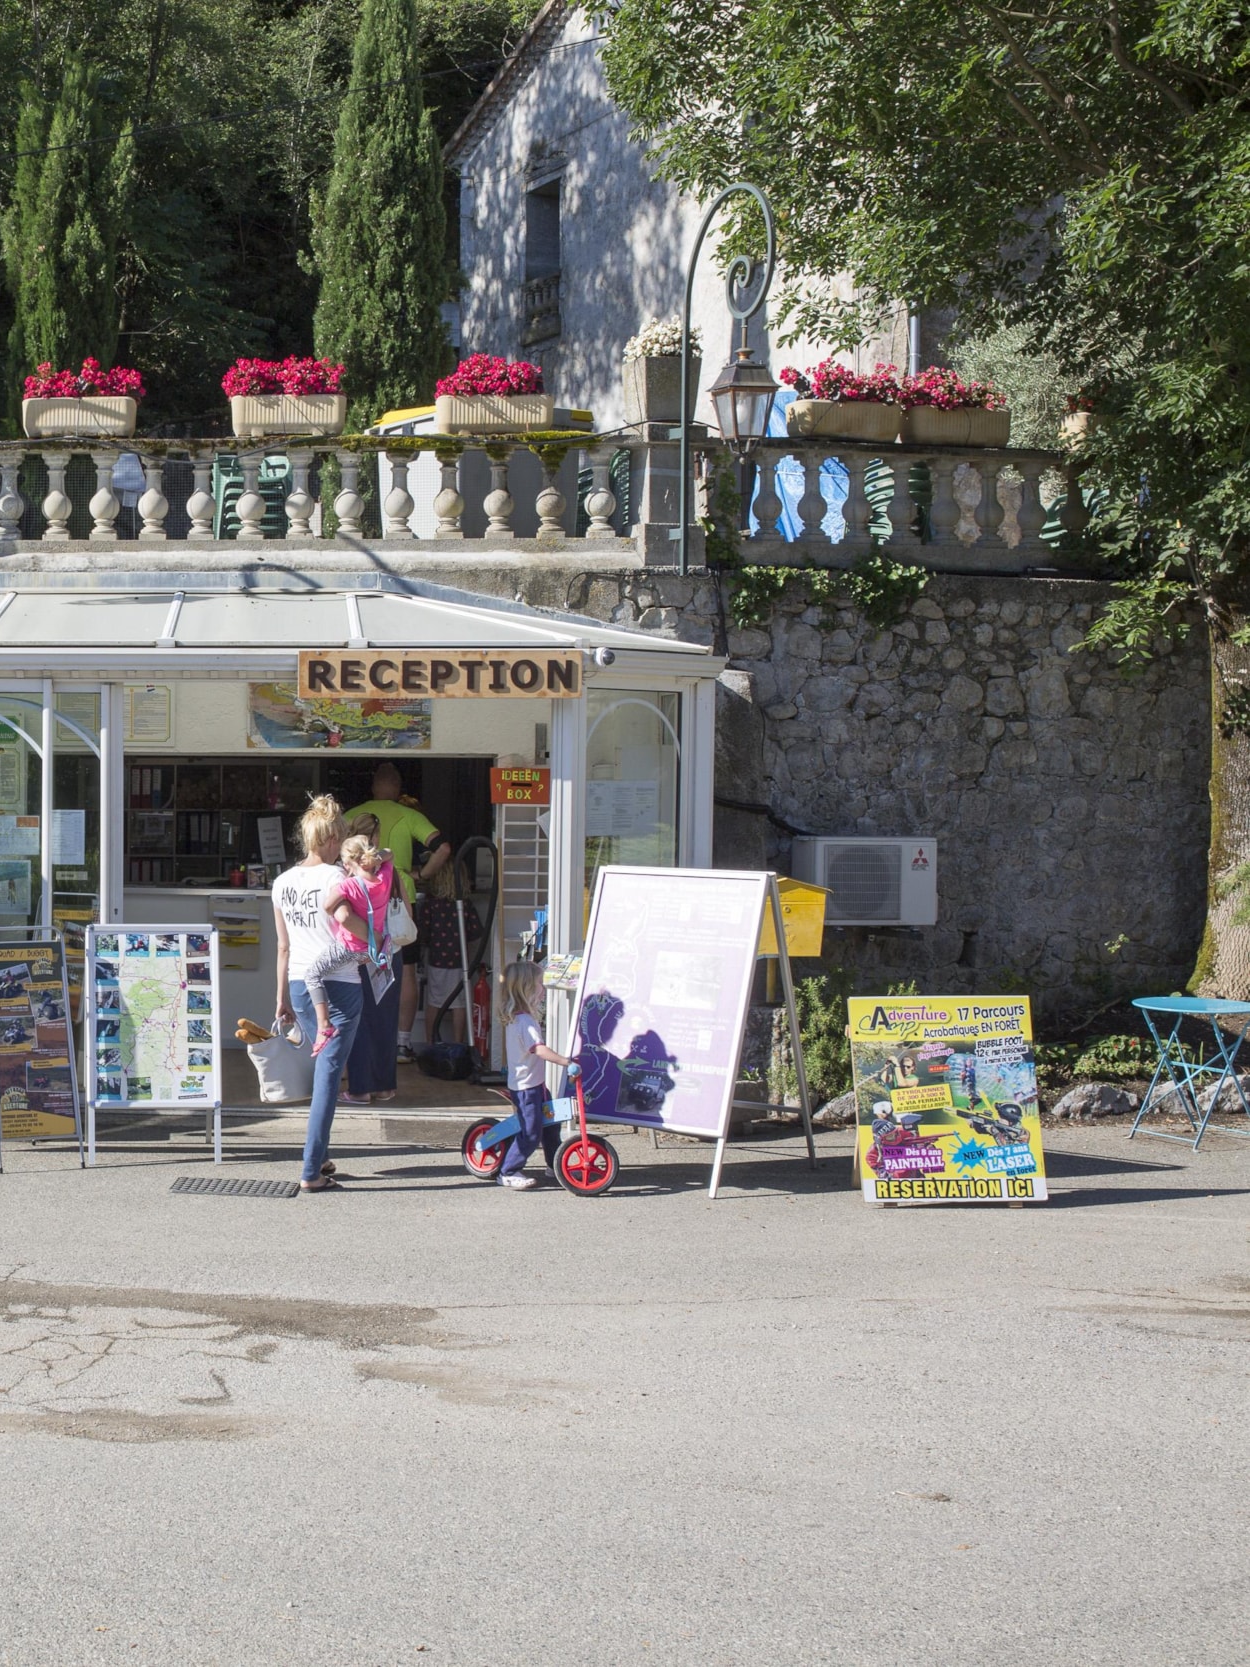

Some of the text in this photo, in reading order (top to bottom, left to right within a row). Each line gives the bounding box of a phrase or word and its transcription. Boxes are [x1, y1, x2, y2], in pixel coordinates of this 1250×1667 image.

[308, 659, 578, 692] RECEPTION
[507, 788, 531, 800] BOX
[301, 889, 321, 909] GET
[957, 1005, 1025, 1021] 17 Parcours
[923, 1016, 1021, 1039] Acrobatiques EN FORÊT
[977, 1036, 1023, 1049] BUBBLE FOOT
[962, 1150, 985, 1161] NEW
[1005, 1146, 1011, 1155] 7
[1012, 1145, 1028, 1153] ans
[884, 1156, 945, 1171] PAINTBALL
[987, 1153, 1035, 1172] LASER
[1006, 1165, 1037, 1177] en forêt
[875, 1178, 1034, 1199] RESERVATION ICI
